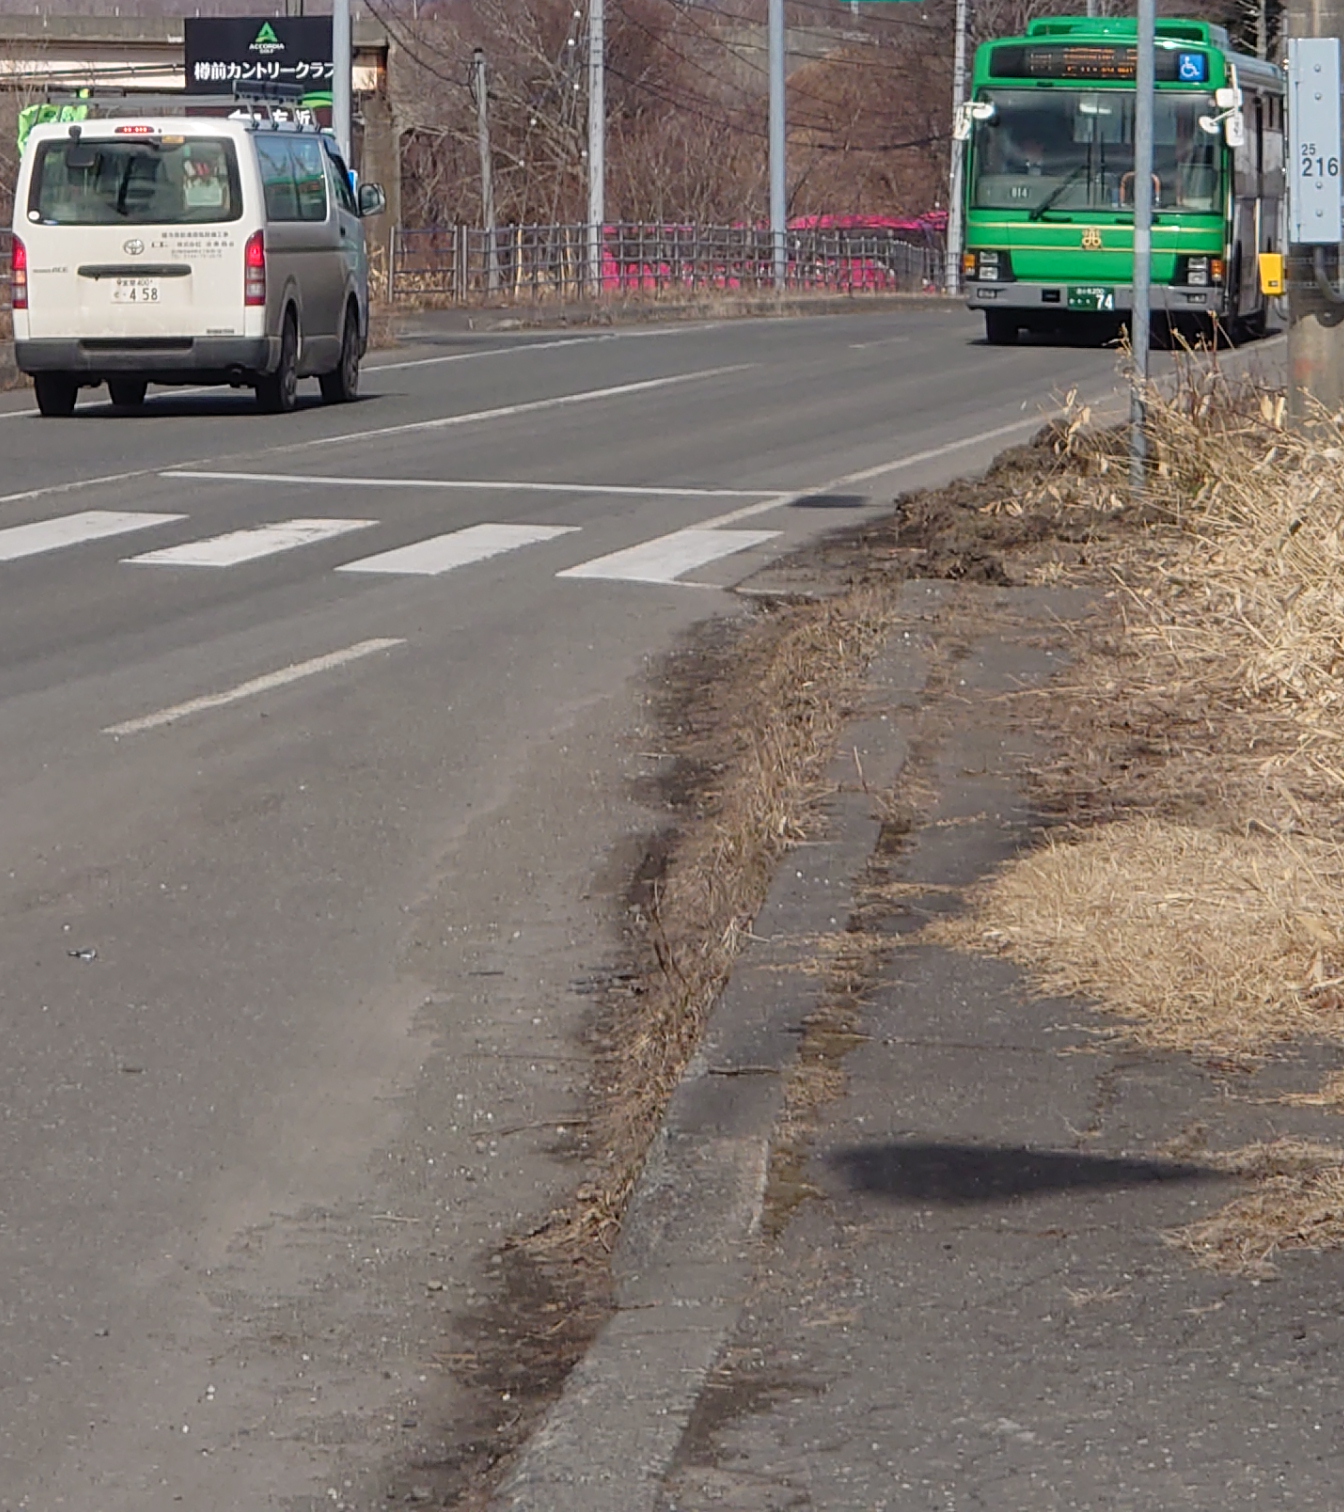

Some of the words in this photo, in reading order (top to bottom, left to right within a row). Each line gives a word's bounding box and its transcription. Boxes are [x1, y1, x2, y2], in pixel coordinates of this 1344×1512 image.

[1301, 143, 1316, 155] 25
[1302, 157, 1339, 176] 216
[1096, 294, 1113, 310] 74
